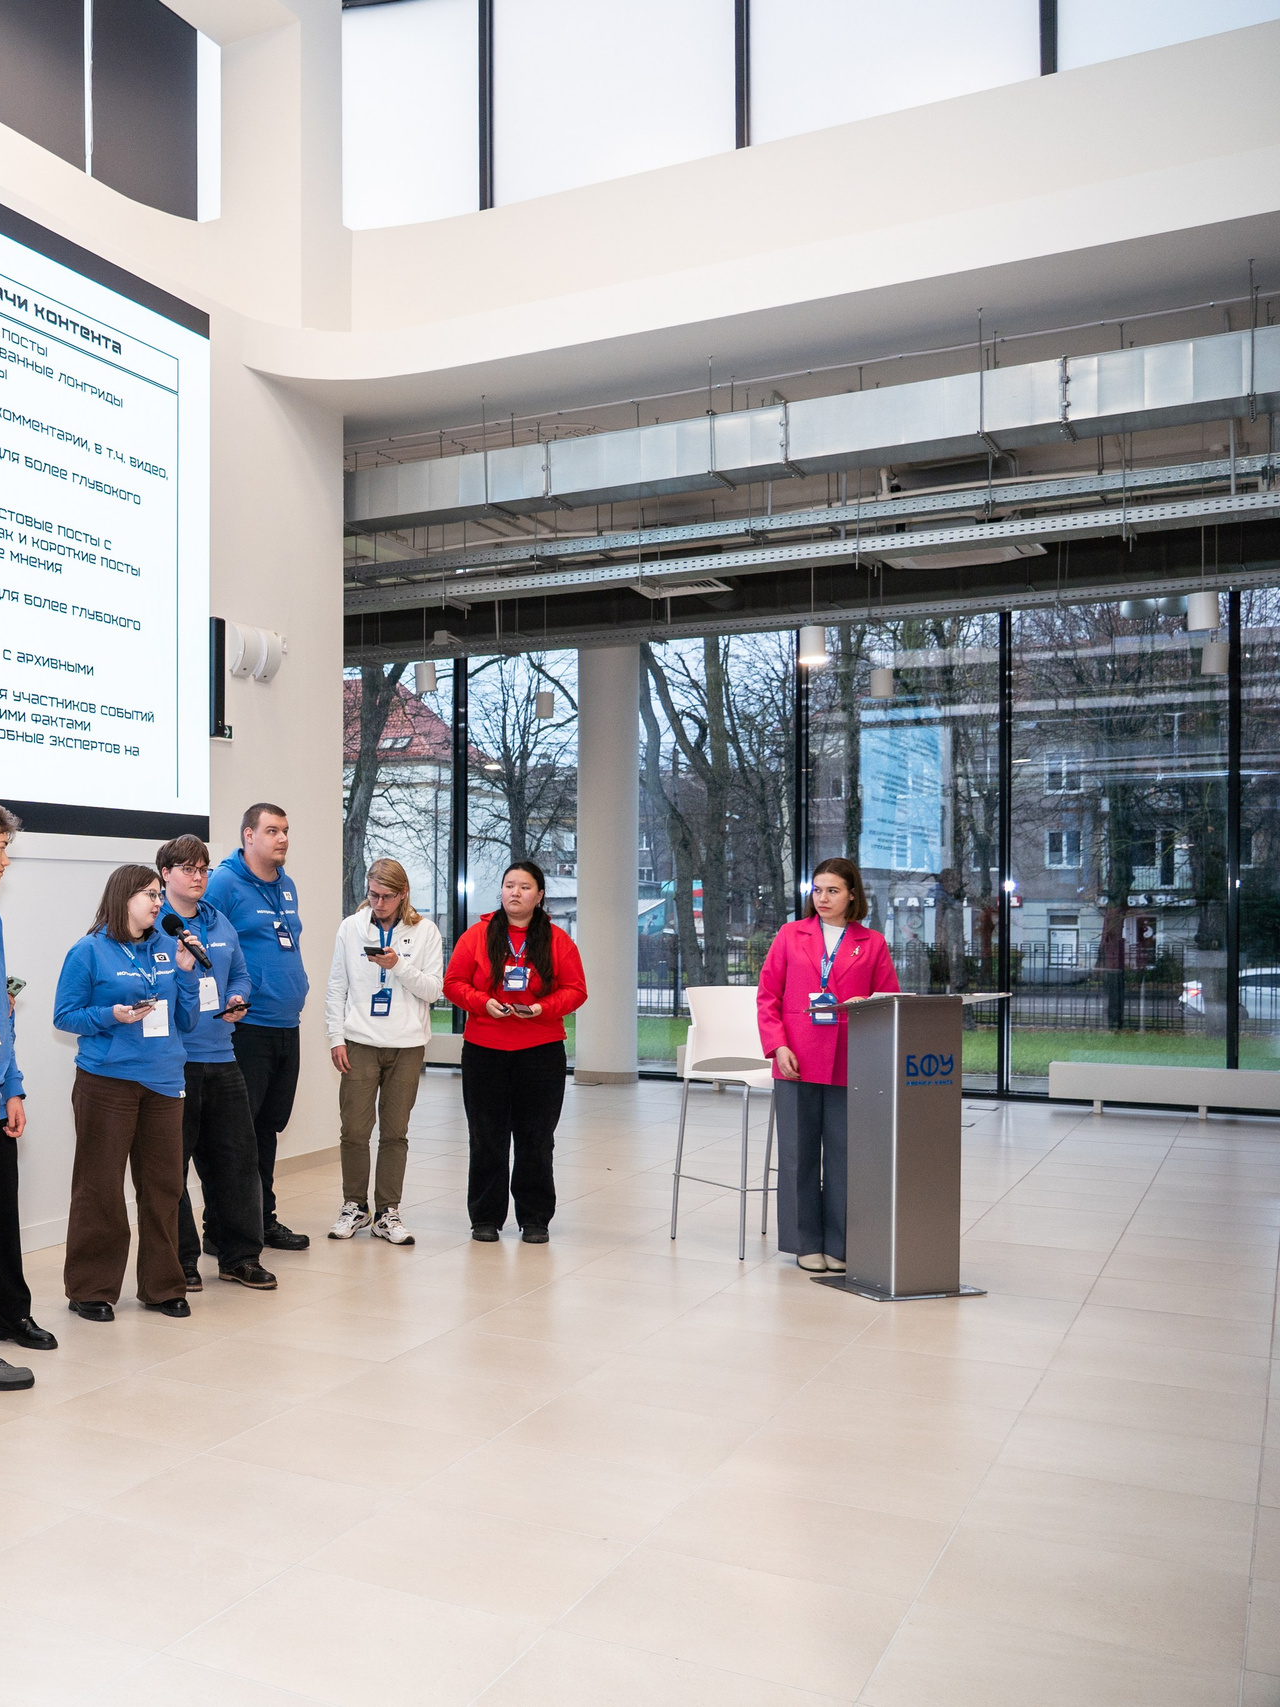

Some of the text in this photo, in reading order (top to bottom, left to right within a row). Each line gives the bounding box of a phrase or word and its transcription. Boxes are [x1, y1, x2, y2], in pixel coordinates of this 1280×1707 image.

[2, 328, 47, 357] посты
[34, 304, 121, 355] контента
[58, 373, 122, 407] лонгриды
[95, 443, 102, 454] в
[130, 456, 168, 480] видео,
[25, 456, 67, 480] более
[72, 473, 140, 505] глубокого
[58, 525, 99, 547] посты
[104, 540, 111, 550] с
[10, 551, 62, 574] мнения
[19, 533, 26, 545] и
[32, 537, 96, 564] короткие
[101, 557, 140, 576] посты
[24, 594, 67, 613] более
[72, 606, 140, 630] глубокого
[3, 649, 11, 660] с
[17, 652, 93, 676] архивными
[13, 691, 96, 713] участников
[101, 705, 154, 722] событий
[31, 714, 90, 731] фактами
[49, 735, 120, 754] экспертов
[124, 746, 139, 756] на
[906, 1053, 954, 1077] БФУ
